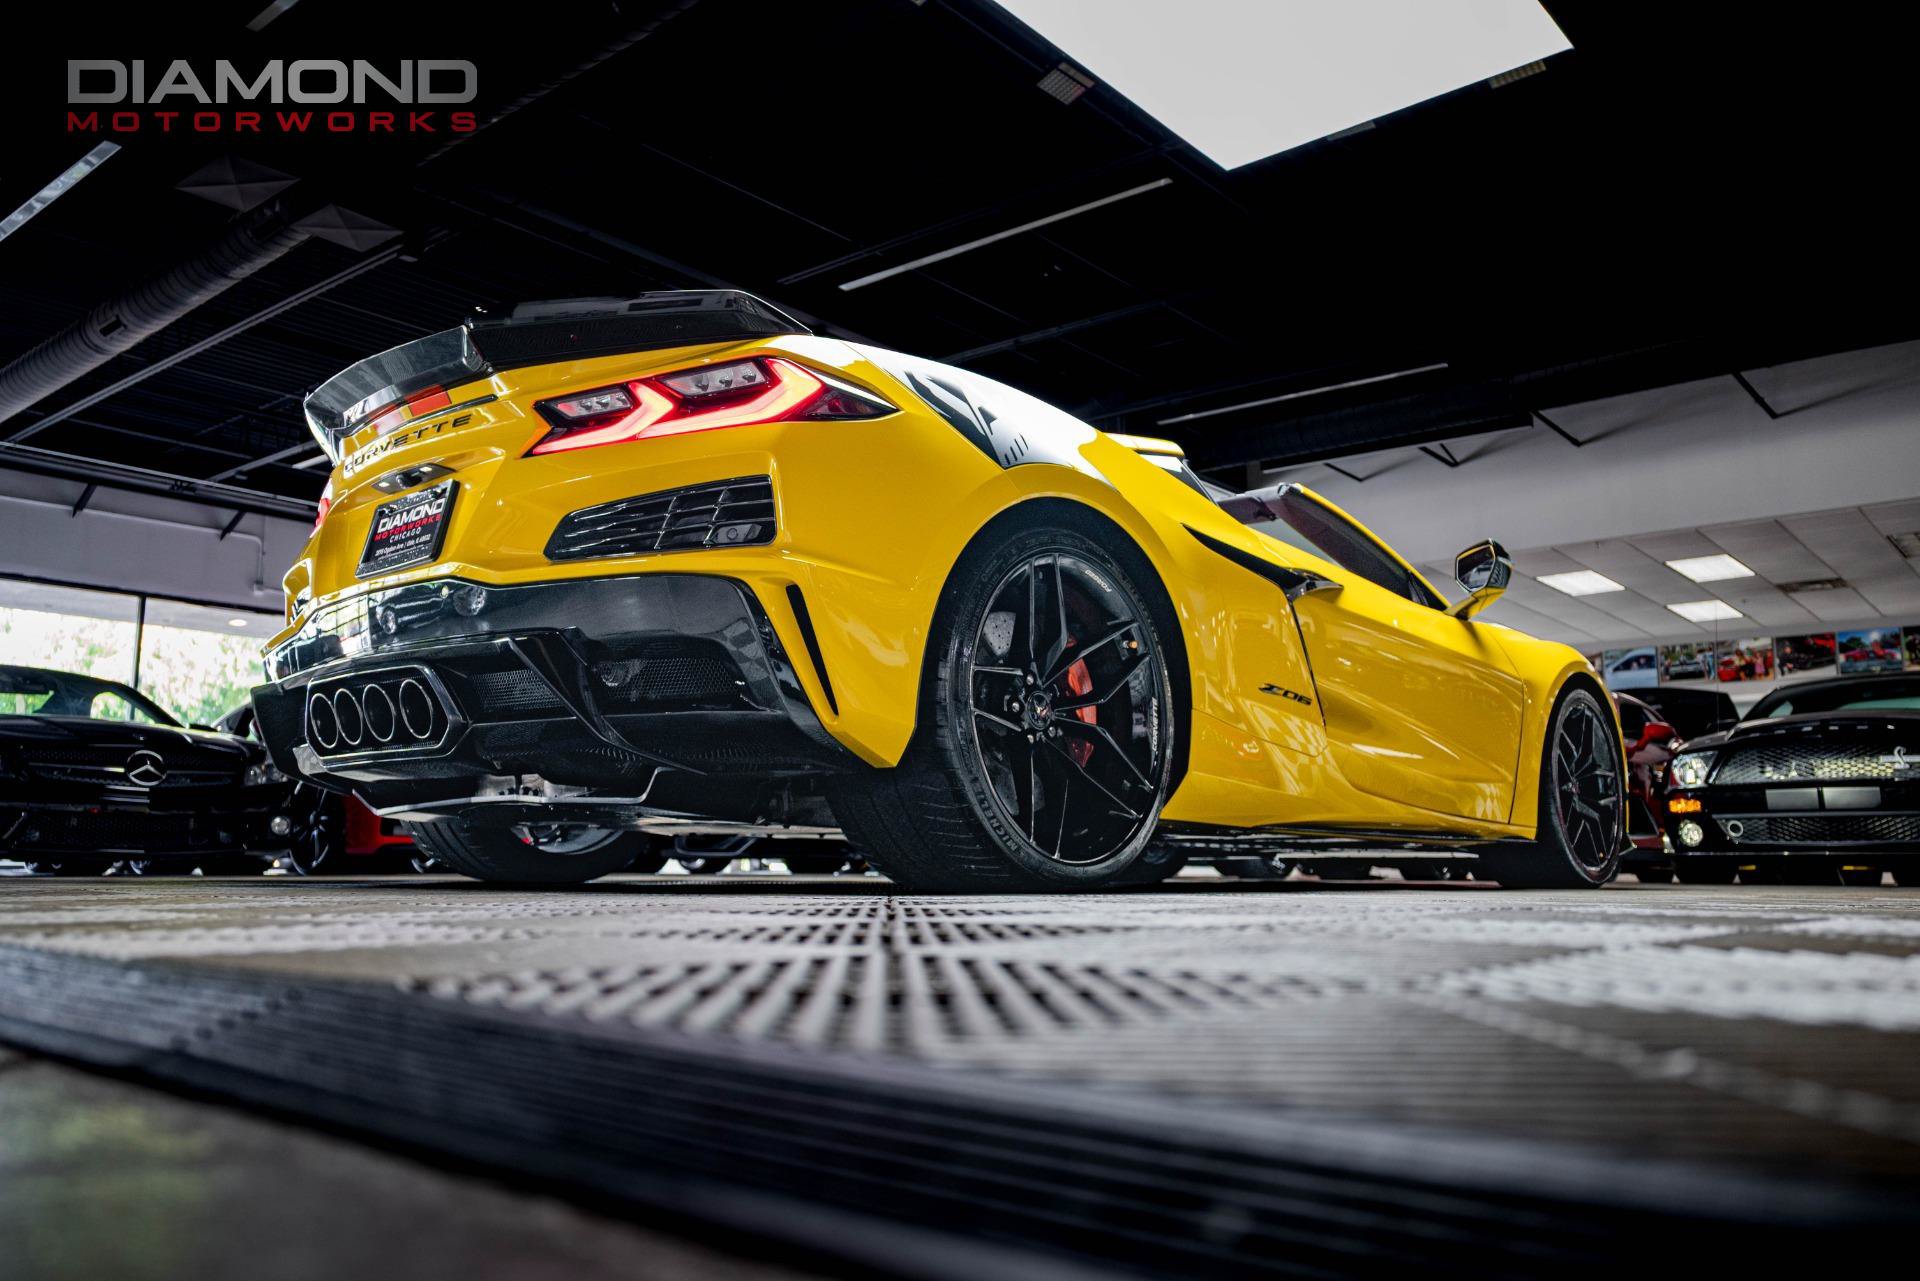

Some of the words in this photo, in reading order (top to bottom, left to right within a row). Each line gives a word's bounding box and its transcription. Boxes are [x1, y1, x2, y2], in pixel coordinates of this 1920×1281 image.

[344, 412, 472, 473] CORVETTE
[373, 513, 442, 542] MOTORWORKS
[377, 498, 446, 533] DIAMOND
[389, 527, 422, 543] CHICAGO
[1084, 569, 1113, 593] FORGED
[1258, 683, 1312, 706] Z06
[1151, 696, 1160, 752] CORVETTE
